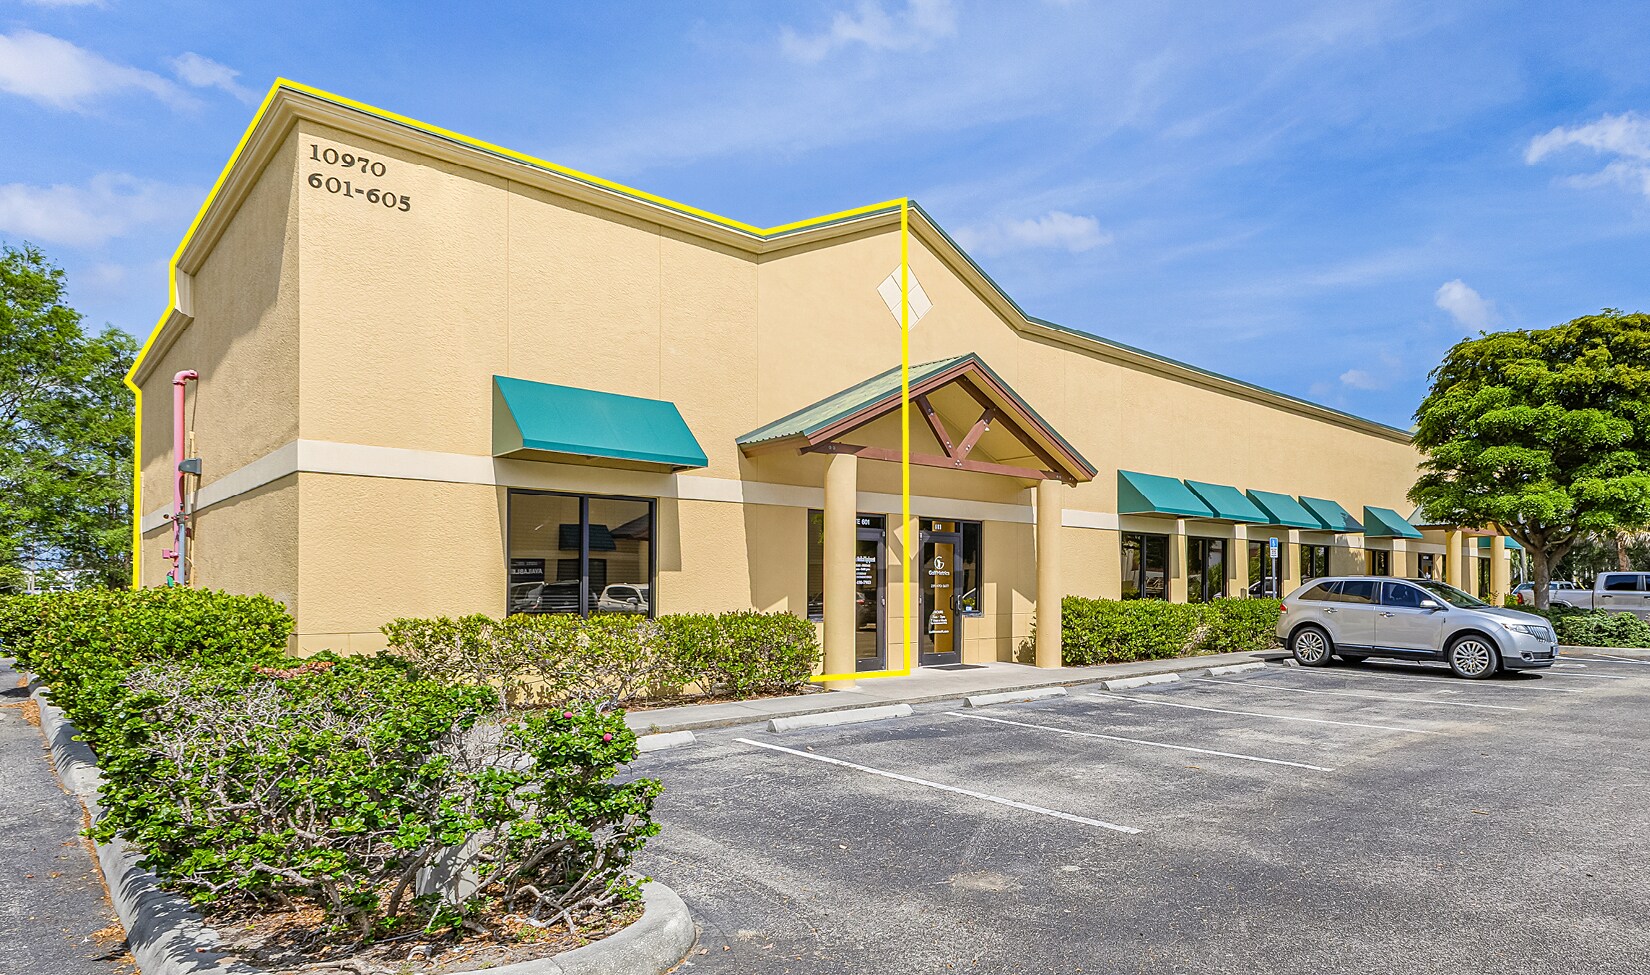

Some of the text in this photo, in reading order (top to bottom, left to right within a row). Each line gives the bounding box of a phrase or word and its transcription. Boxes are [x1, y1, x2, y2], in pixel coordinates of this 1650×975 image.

[309, 144, 387, 177] 10970
[307, 172, 411, 212] 601-605
[861, 518, 871, 526] 601
